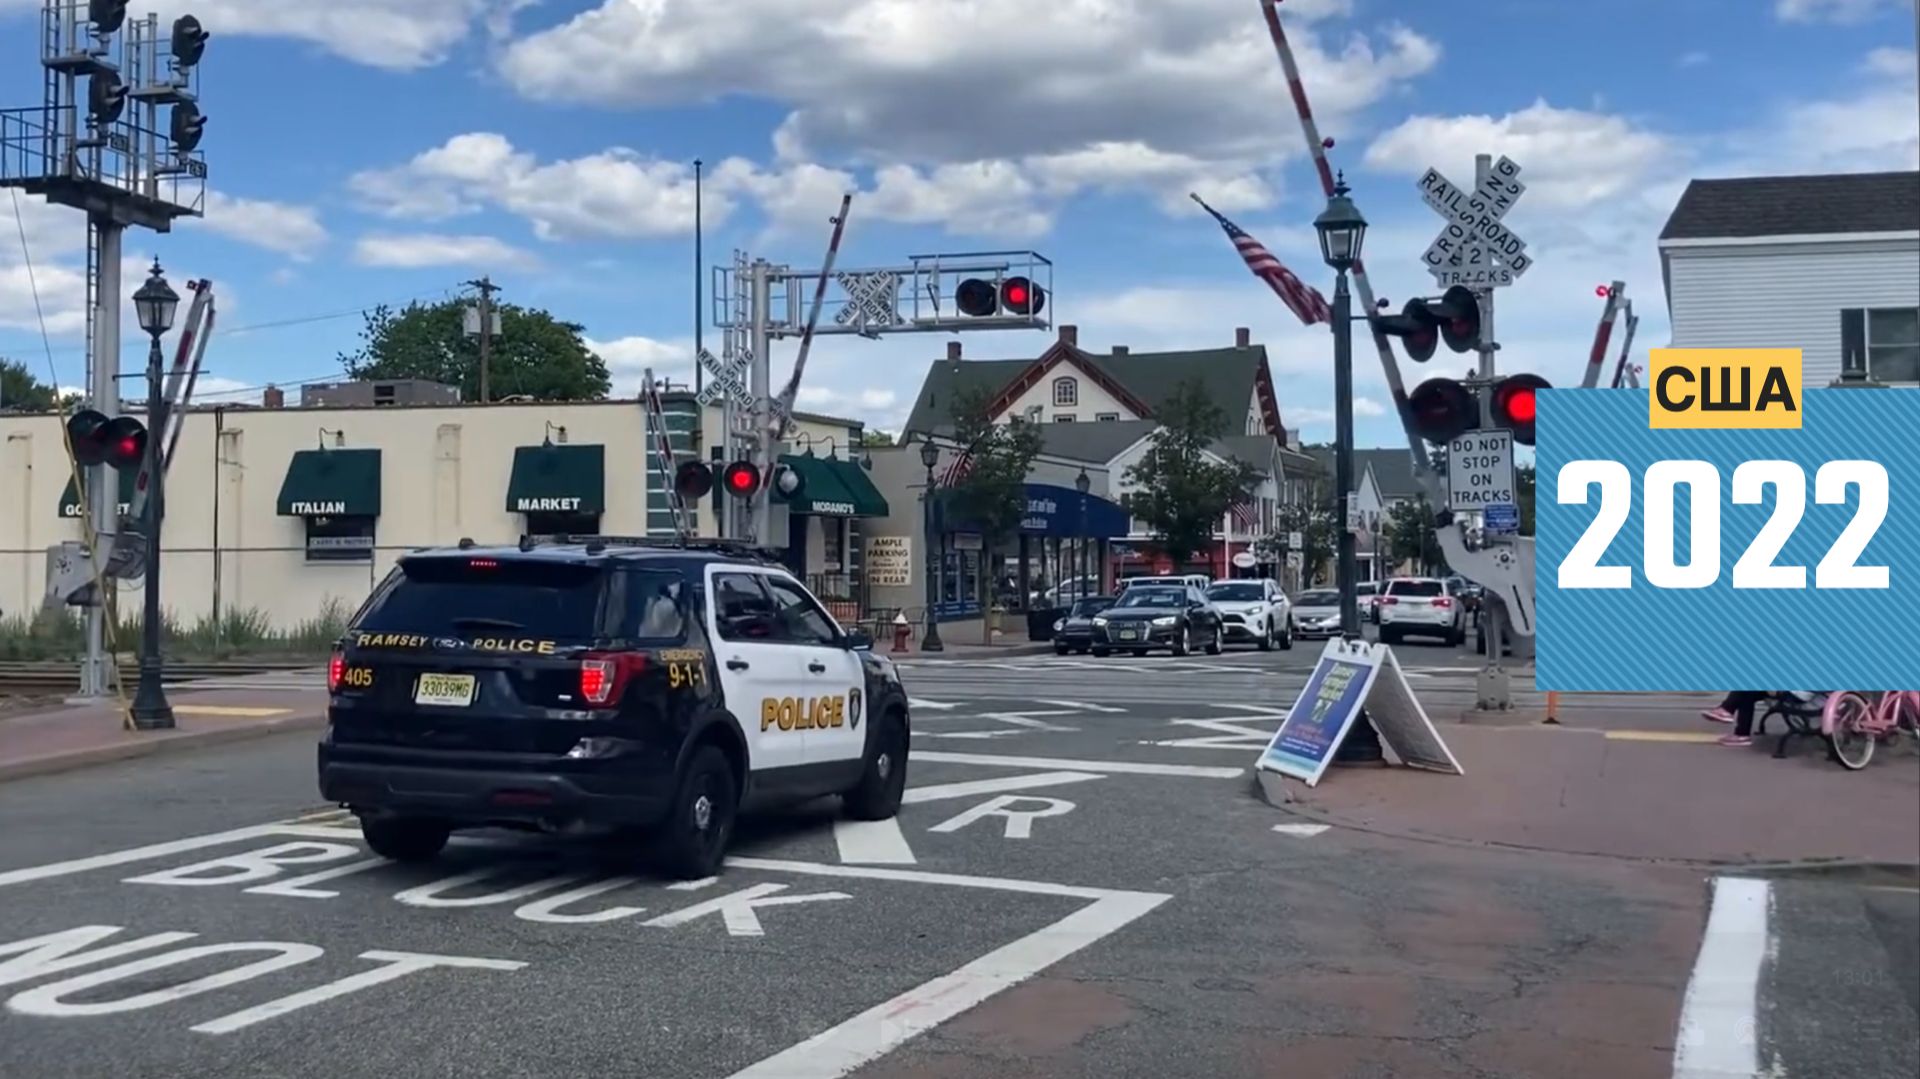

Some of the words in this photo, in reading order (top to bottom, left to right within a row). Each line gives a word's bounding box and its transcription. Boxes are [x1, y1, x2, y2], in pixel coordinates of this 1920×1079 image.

[1422, 172, 1520, 255] RAILROAD
[1427, 161, 1514, 265] CROSSING
[1469, 247, 1481, 265] 2
[835, 271, 887, 323] CROSSING
[837, 271, 887, 324] RAILROAD
[699, 350, 753, 406] RAILROAD
[700, 350, 753, 405] CROSSING
[1453, 440, 1473, 452] DO
[1479, 438, 1507, 451] NOT
[1462, 455, 1501, 469] STOP
[1470, 474, 1492, 486] ON
[517, 497, 581, 511] MARKET
[1453, 489, 1511, 503] TRACKS
[65, 503, 130, 516] GOET
[291, 501, 346, 514] ITALIAN
[812, 501, 855, 514] MORANO'S
[874, 538, 902, 547] AMPLE
[867, 549, 908, 557] PARKING
[357, 633, 428, 647] RAMSEY
[473, 638, 556, 654] POLICE
[344, 668, 373, 686] 405
[669, 662, 707, 688] 9-1-1
[761, 696, 844, 732] POLICE
[0, 925, 530, 1034] NOT
